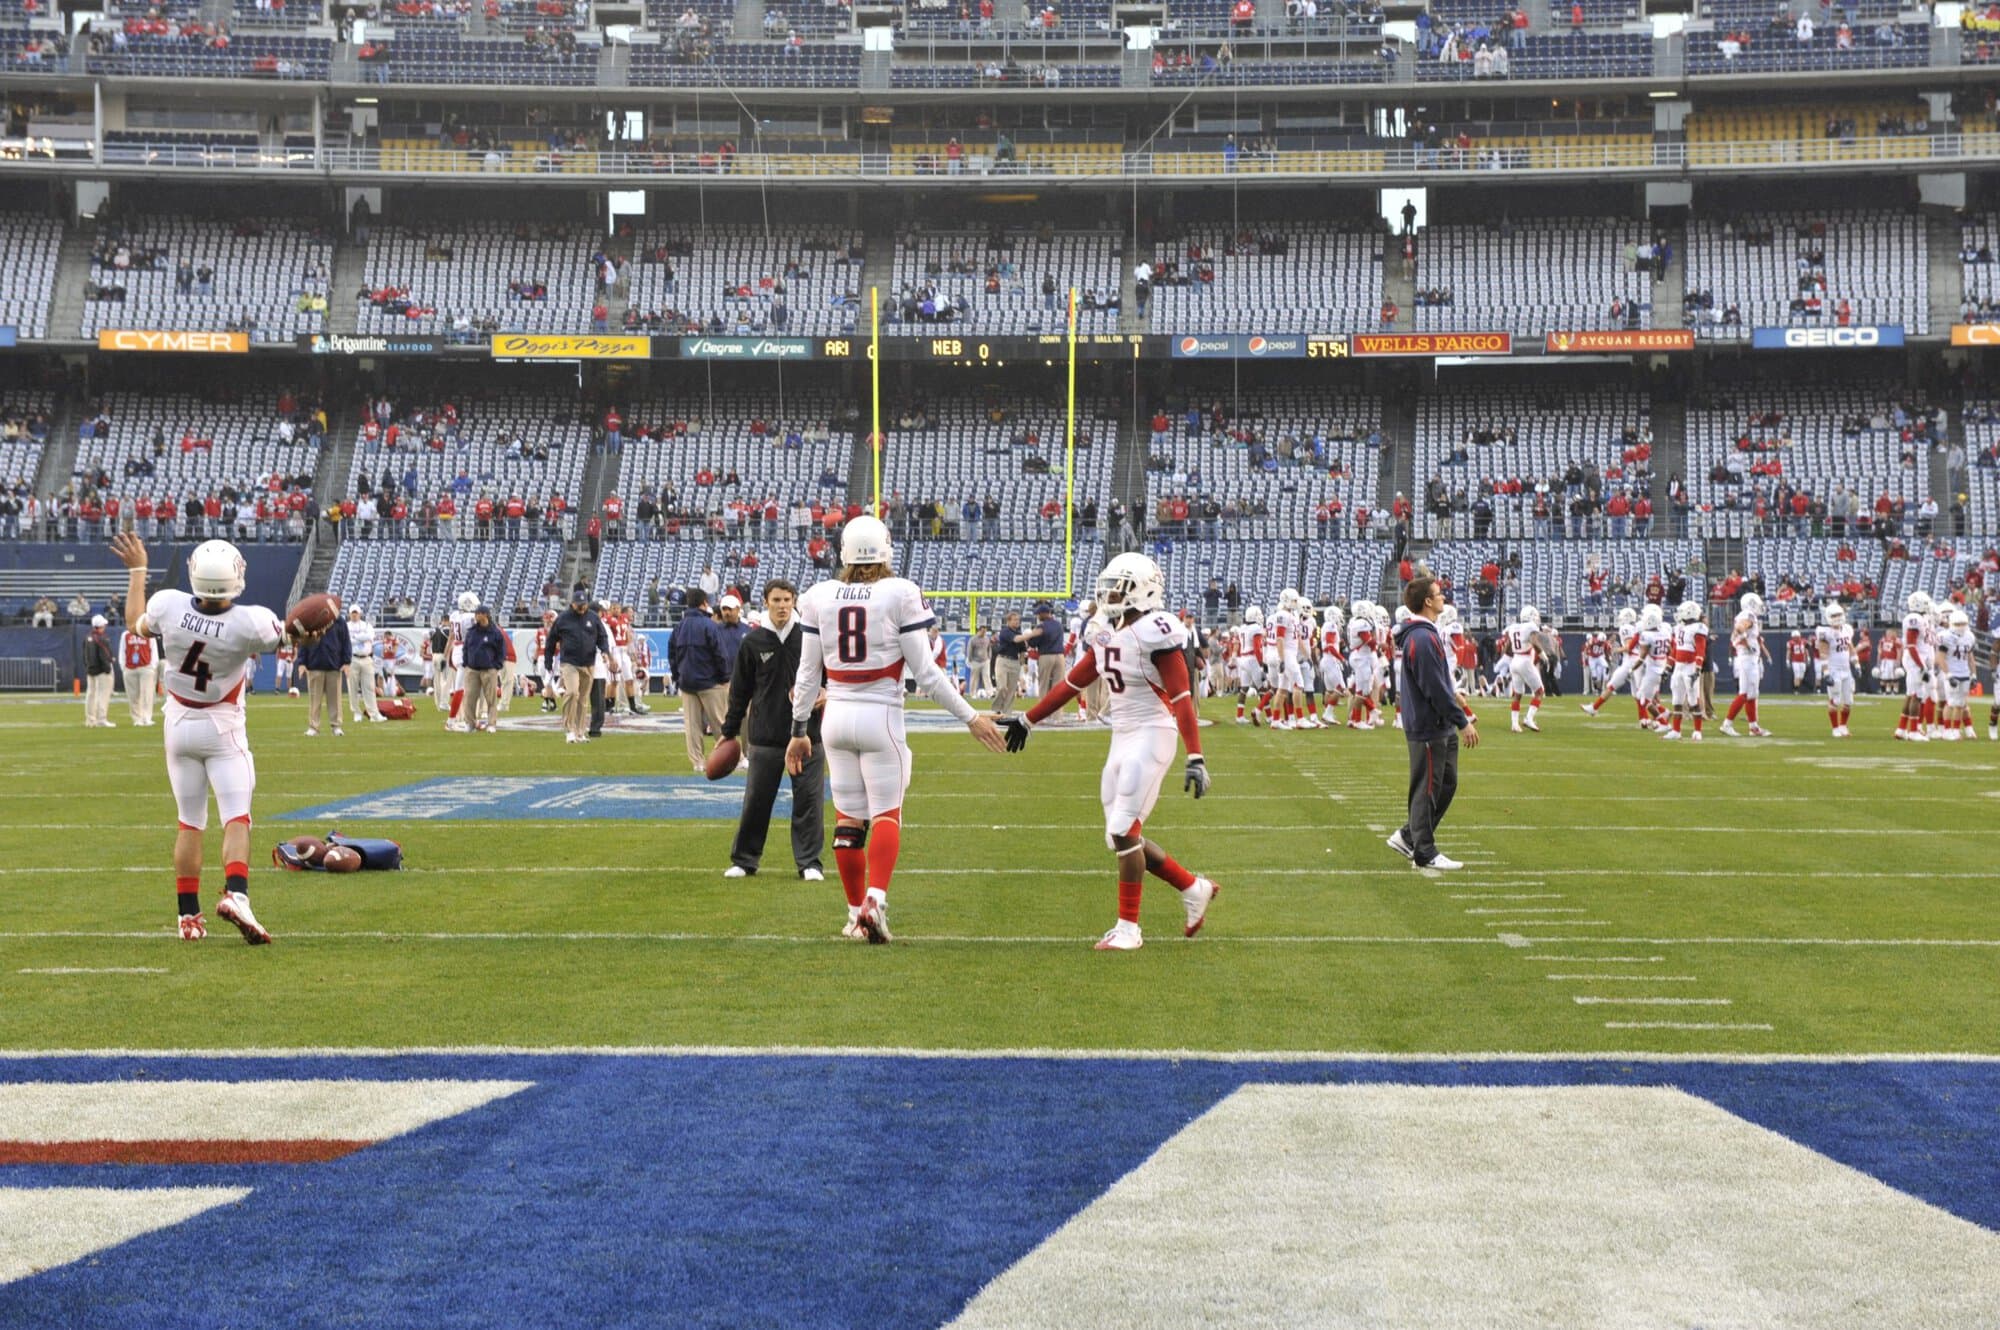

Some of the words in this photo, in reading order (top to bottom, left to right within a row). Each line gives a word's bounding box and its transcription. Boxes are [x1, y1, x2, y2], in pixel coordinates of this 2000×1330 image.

[115, 331, 233, 351] CYMER
[330, 334, 387, 354] Brigantine
[387, 343, 433, 351] SEAFOOD
[1039, 336, 1061, 344] DOWN
[1360, 337, 1430, 352] WELLS
[1434, 336, 1502, 350] FARGO
[1580, 336, 1632, 346] SYCUAN
[1639, 335, 1690, 345] RESORT
[1785, 327, 1879, 347] GEICO
[573, 338, 637, 354] Pizza
[702, 342, 743, 356] Degree
[764, 342, 805, 356] Degree
[825, 341, 849, 356] ARI
[932, 340, 961, 355] NEB
[1200, 341, 1228, 352] pepsi
[1268, 340, 1296, 351] pepsi
[835, 587, 871, 600] FOLES
[180, 612, 225, 639] SCOTT
[1153, 616, 1171, 635] 5
[838, 606, 867, 663] 8
[1513, 631, 1522, 650] 6
[179, 640, 213, 693] 4
[1104, 647, 1126, 694] 5
